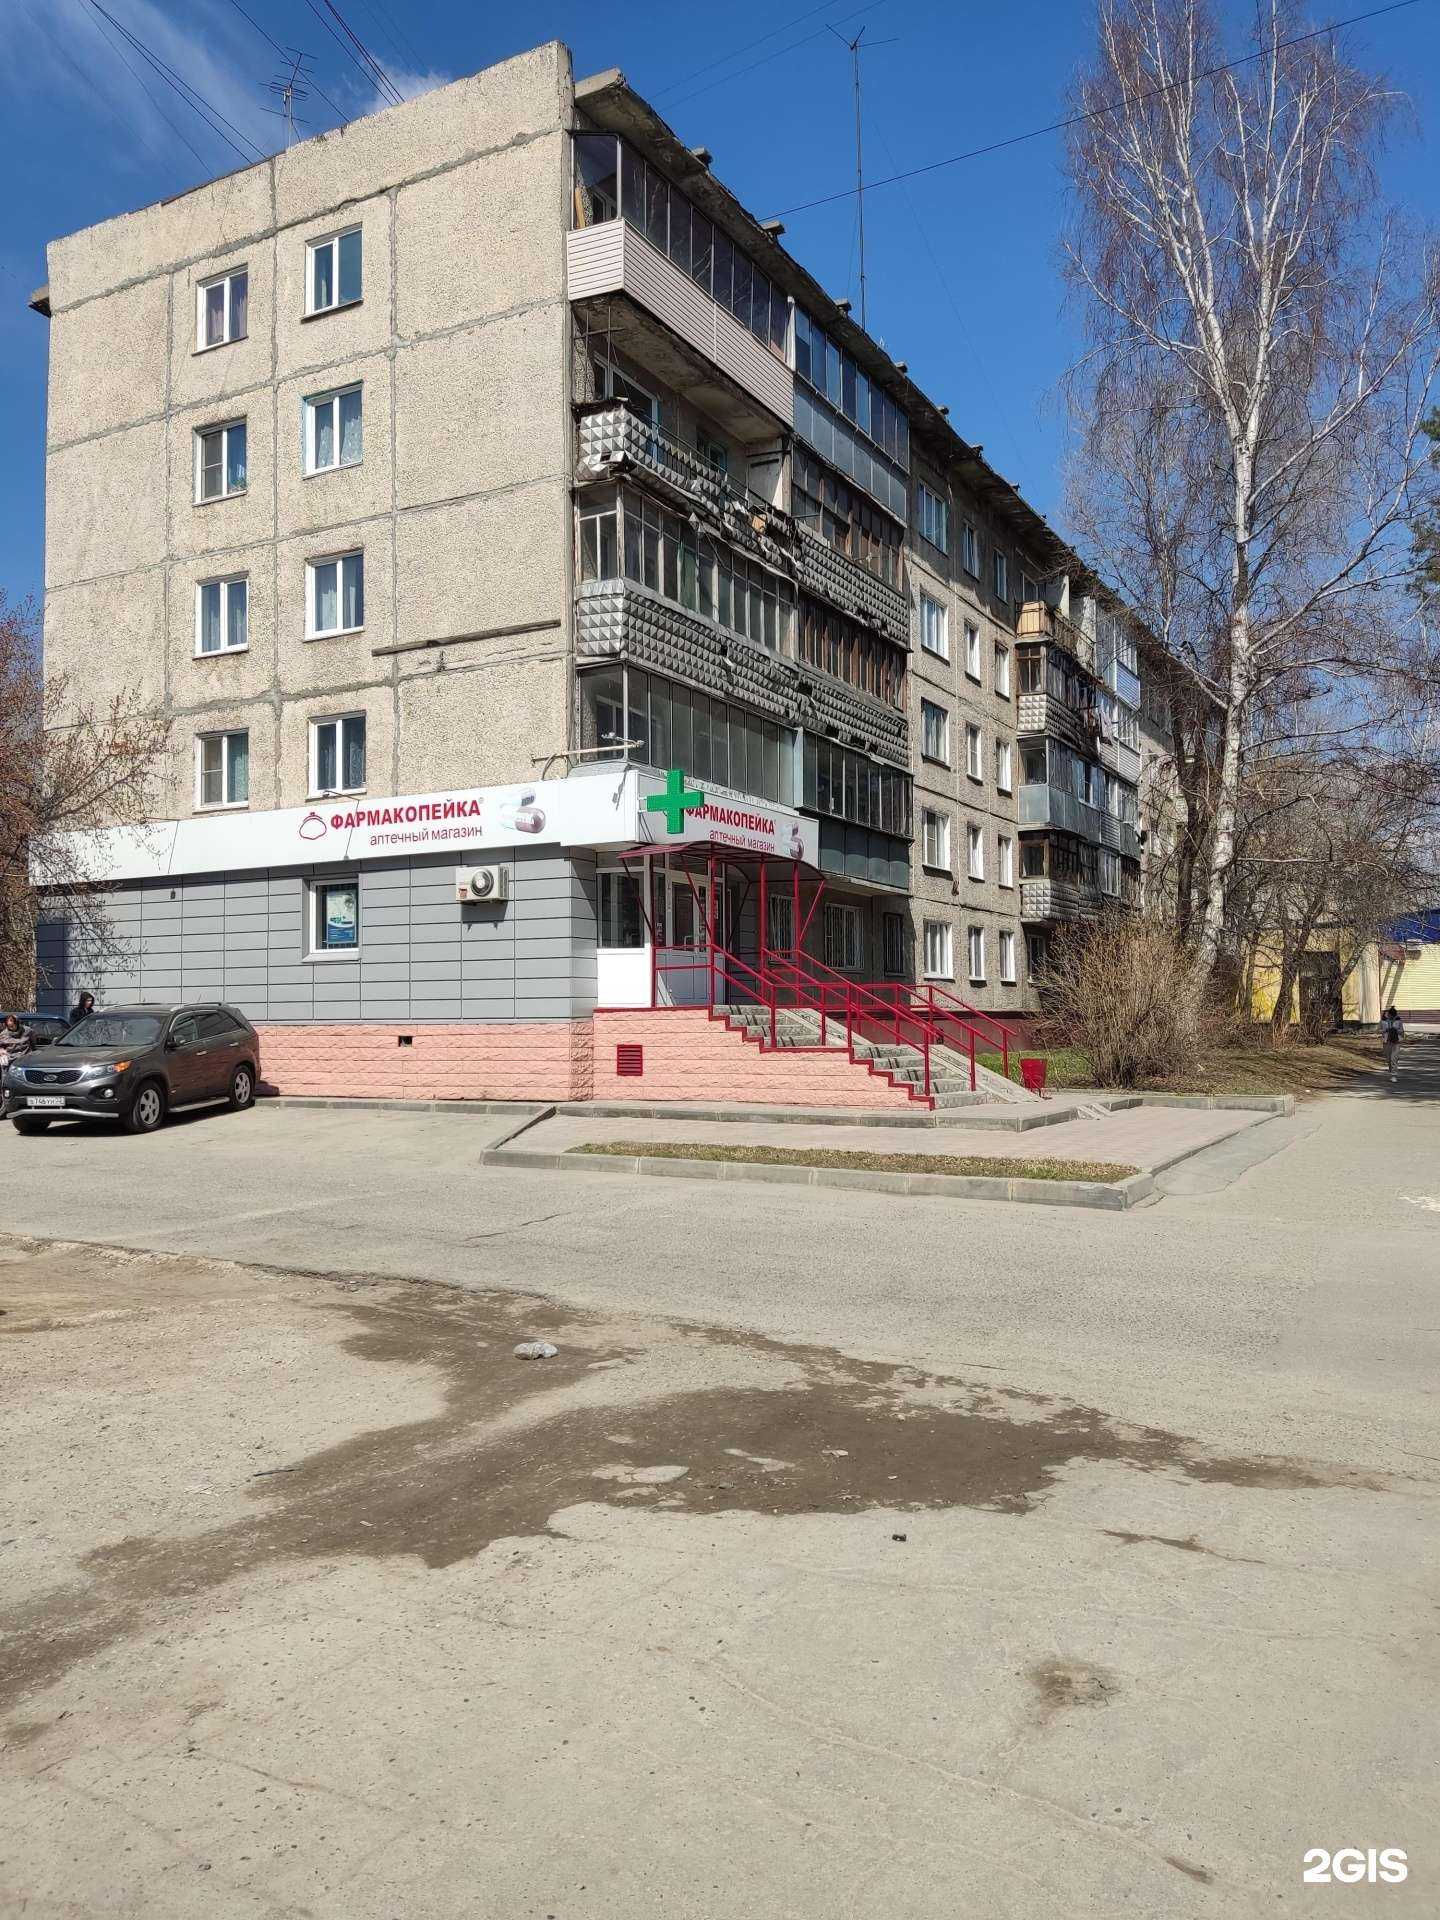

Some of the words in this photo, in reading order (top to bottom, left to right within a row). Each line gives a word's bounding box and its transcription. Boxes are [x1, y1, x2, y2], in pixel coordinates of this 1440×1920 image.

[330, 798, 481, 829] ФАРМАКОПЕЙКА
[370, 828, 429, 846] аптечный
[431, 826, 482, 841] магазин
[709, 829, 746, 847] аптечный
[747, 838, 775, 852] магазин
